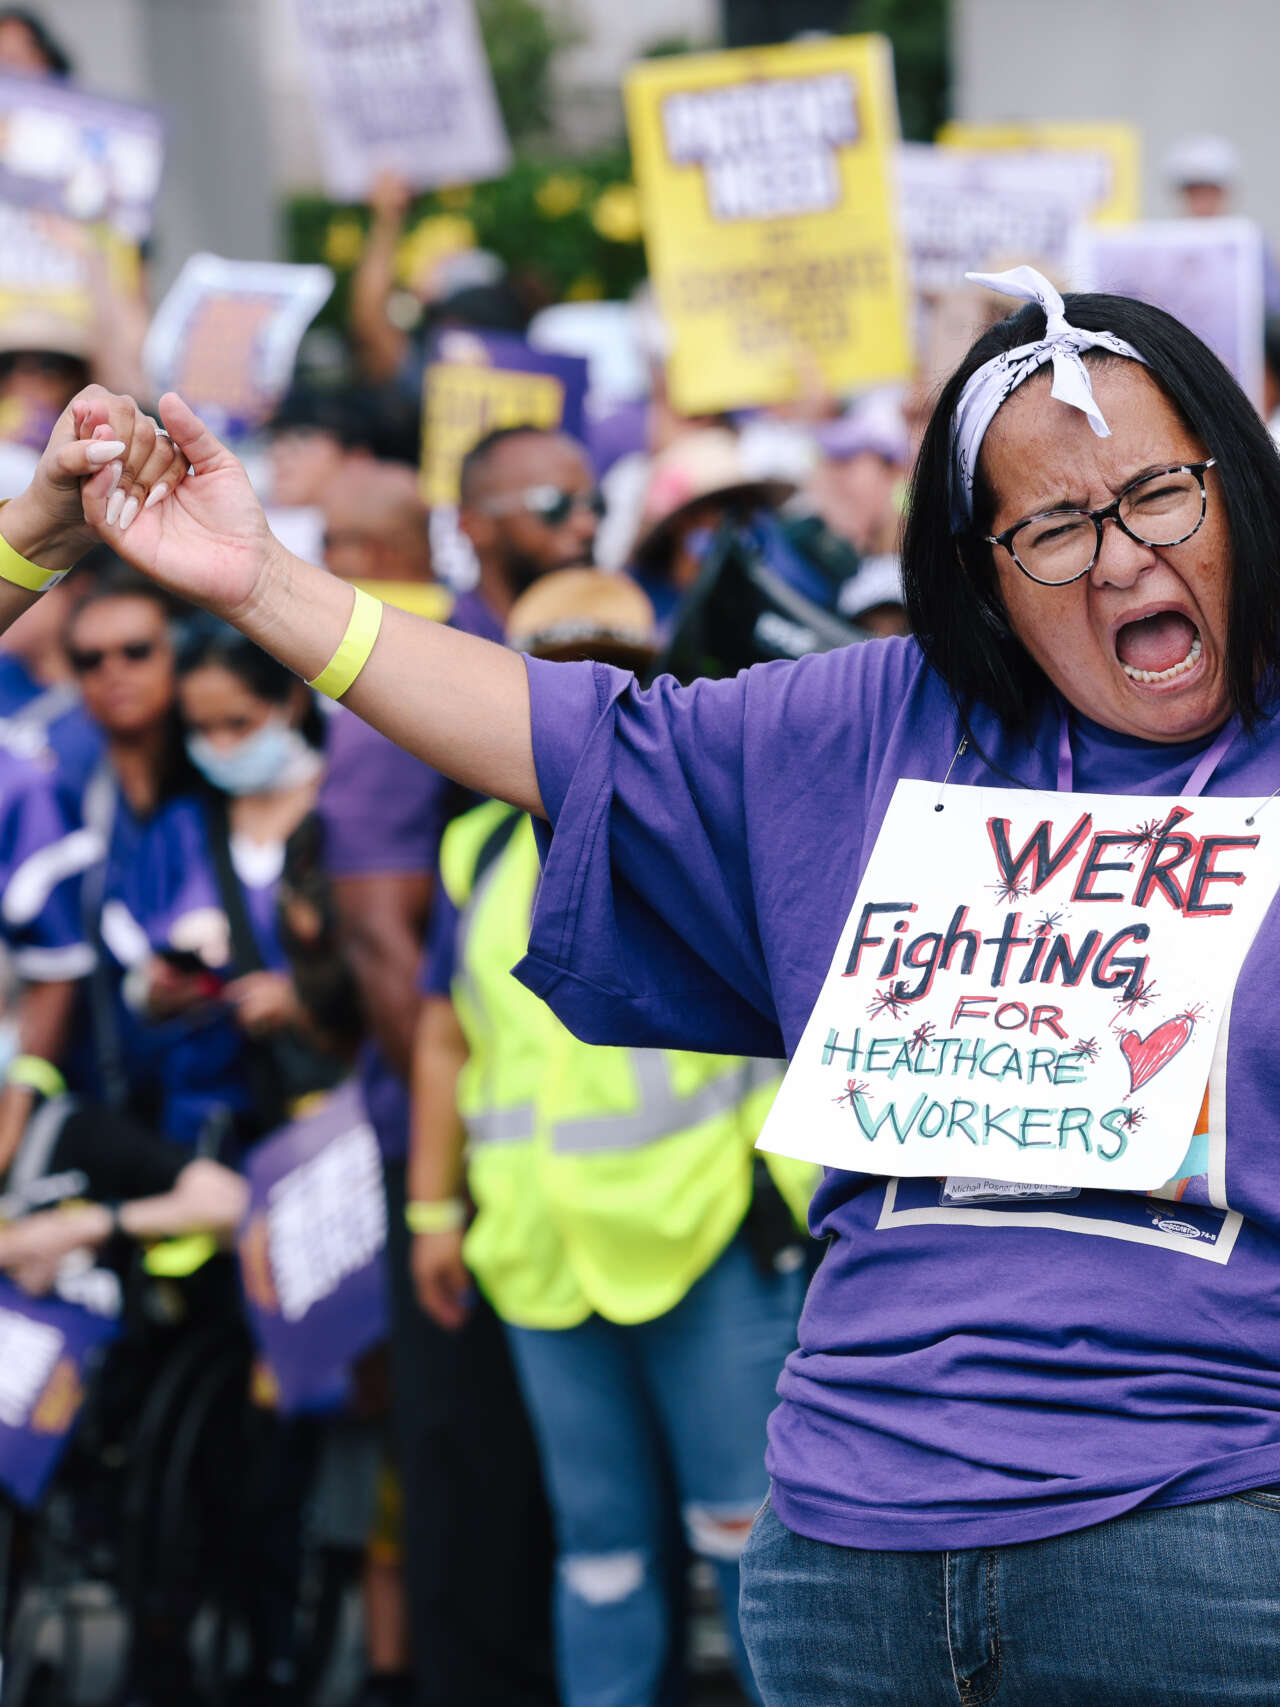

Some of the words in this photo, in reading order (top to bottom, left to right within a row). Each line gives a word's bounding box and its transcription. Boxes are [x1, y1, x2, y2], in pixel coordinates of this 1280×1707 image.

[950, 996, 1069, 1039] FOR
[821, 1027, 1087, 1085] HEALTHCARE
[850, 1090, 1131, 1161] WORKERS
